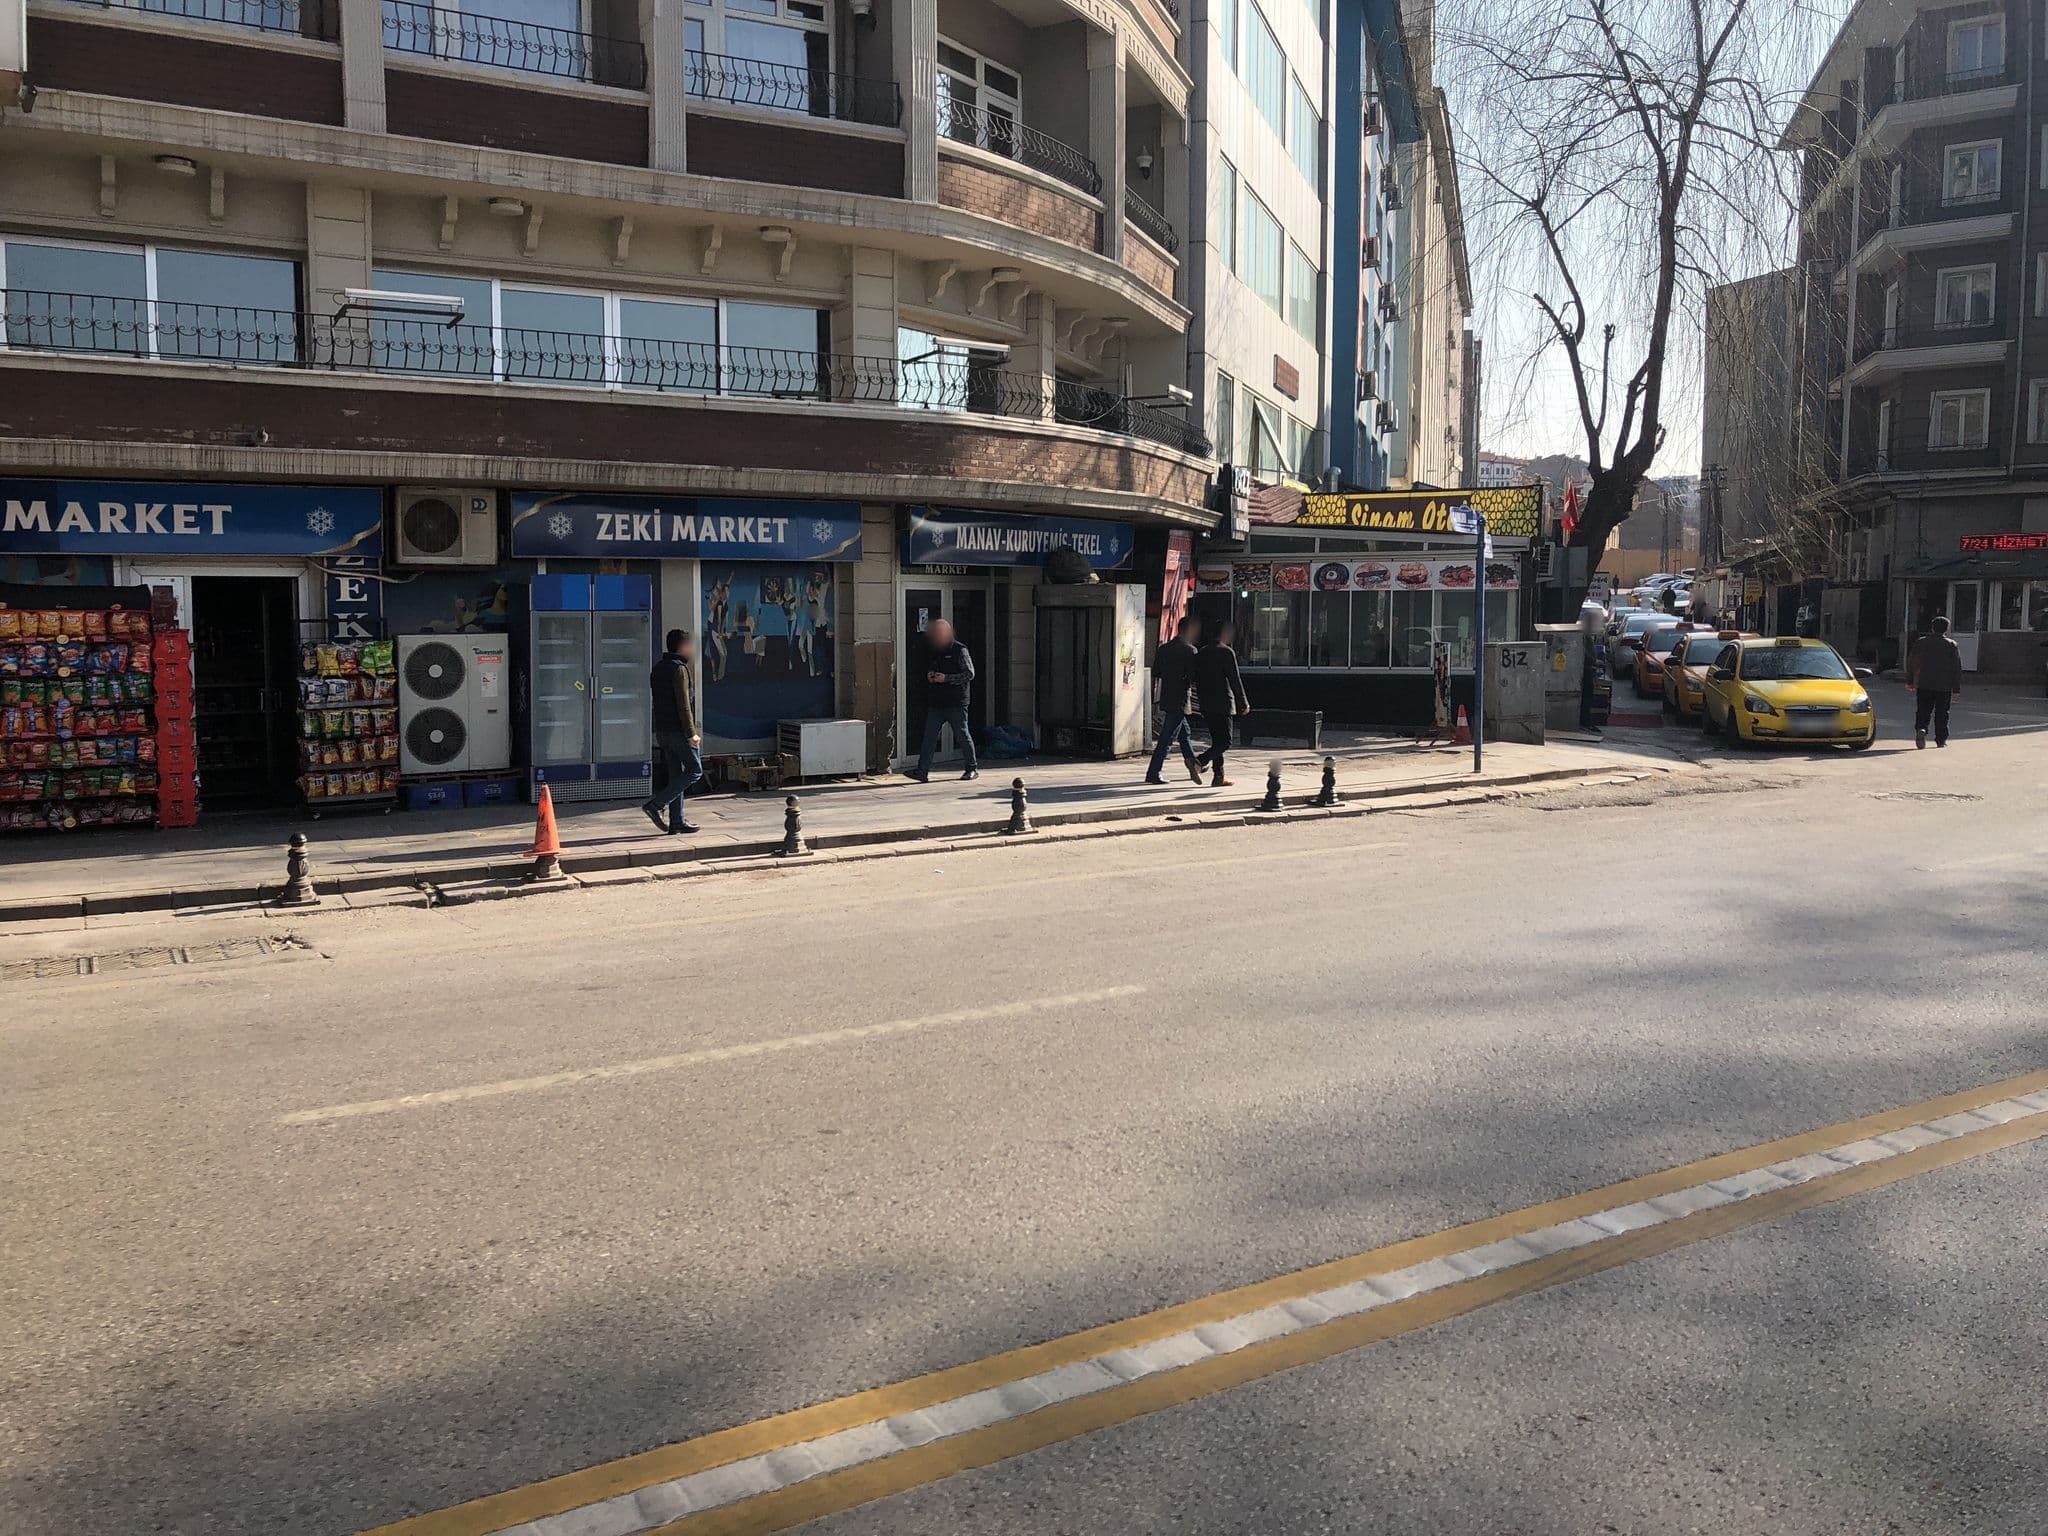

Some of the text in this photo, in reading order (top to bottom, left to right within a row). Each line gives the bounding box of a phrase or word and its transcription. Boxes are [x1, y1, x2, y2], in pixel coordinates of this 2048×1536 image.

[2, 500, 233, 535] MARKET
[596, 508, 789, 543] ZEKİ MARKET
[925, 564, 969, 575] MARKET
